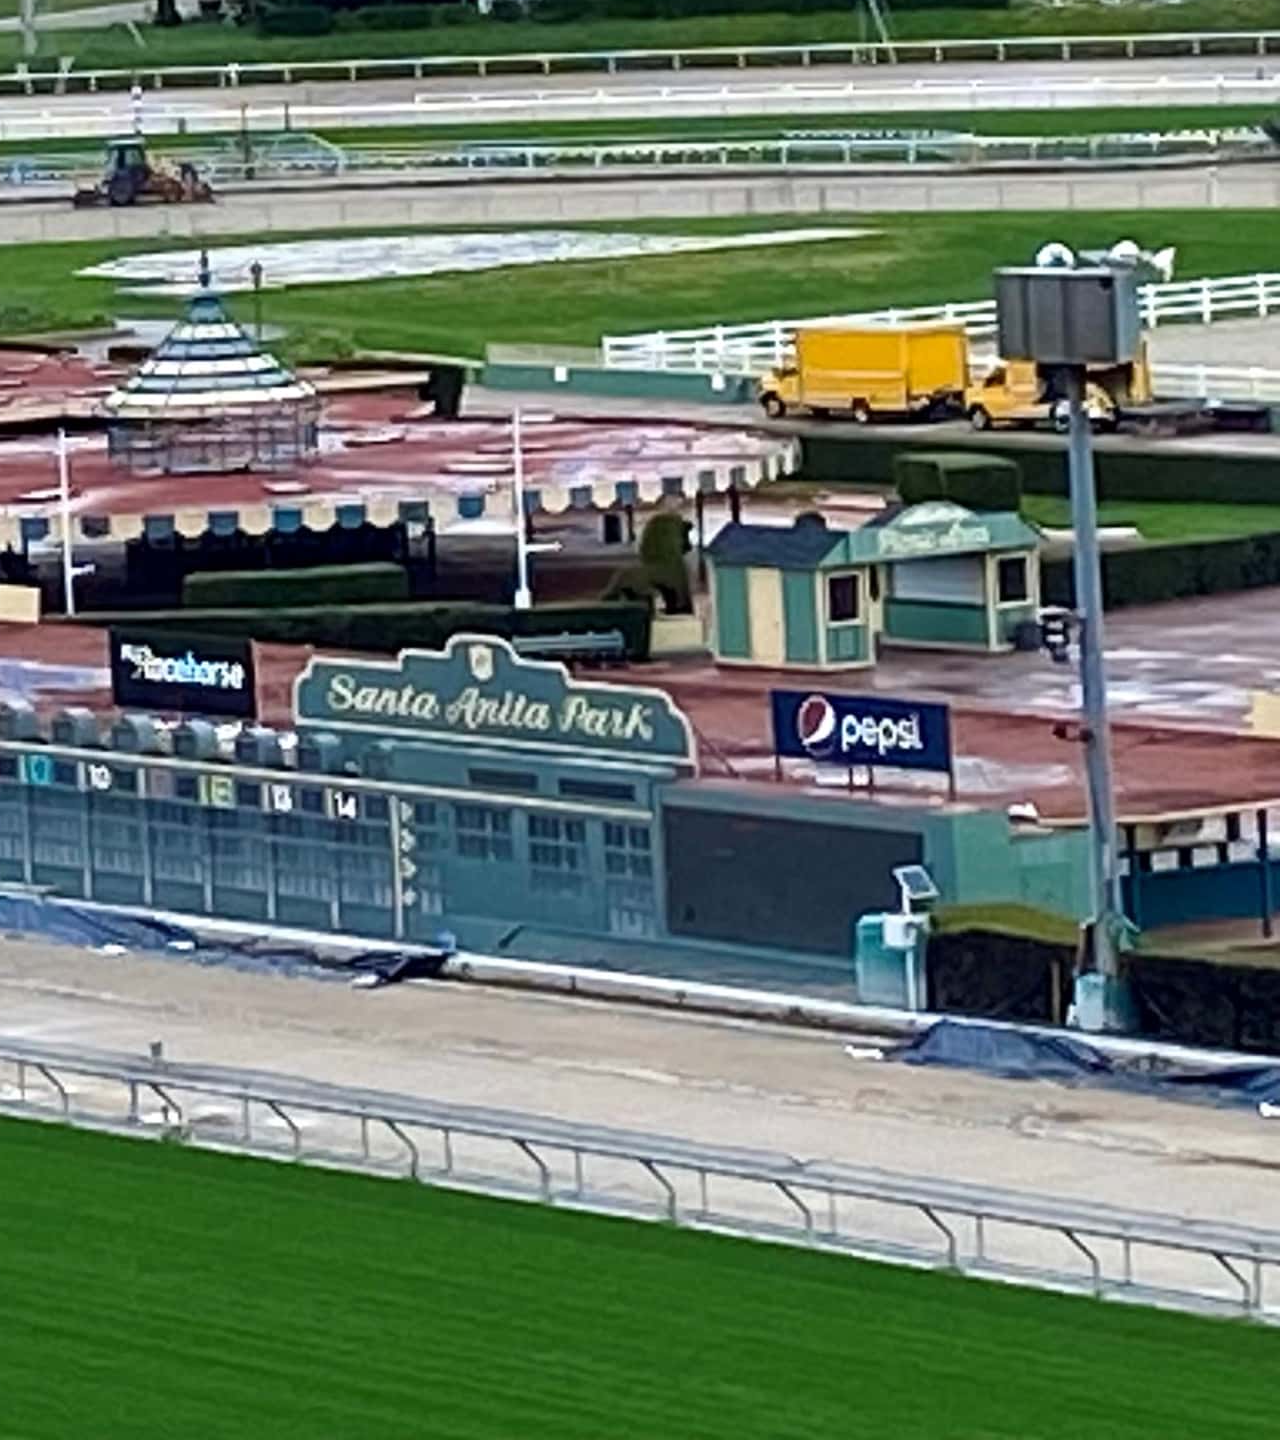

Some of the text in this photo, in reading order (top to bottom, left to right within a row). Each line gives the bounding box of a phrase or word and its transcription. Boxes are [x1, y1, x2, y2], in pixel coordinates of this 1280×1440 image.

[328, 673, 653, 741] Santa Anita Park
[841, 711, 923, 756] pepsi
[88, 763, 112, 791] 10
[334, 791, 357, 820] 14
